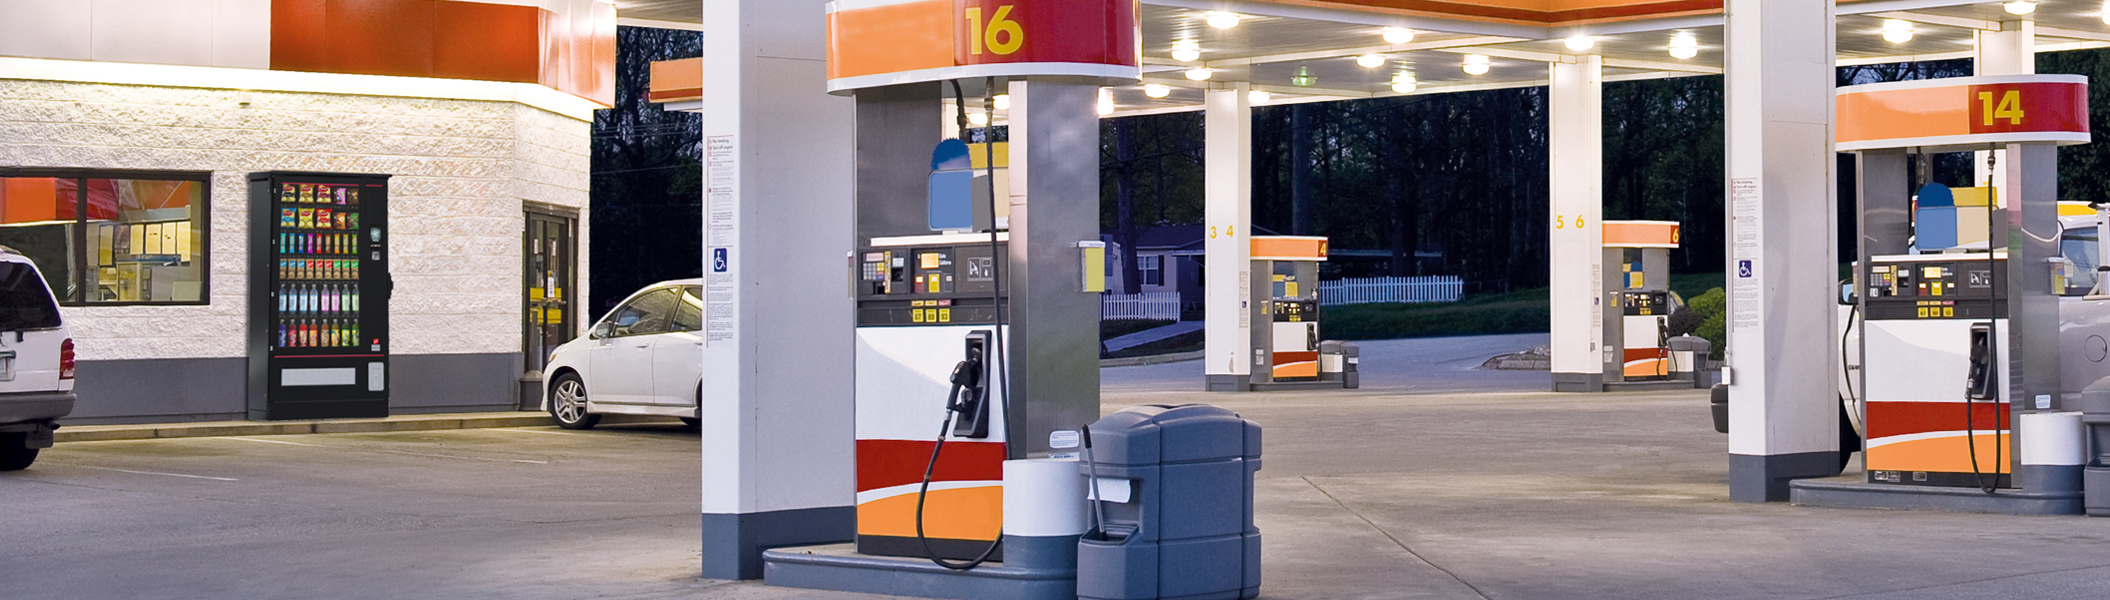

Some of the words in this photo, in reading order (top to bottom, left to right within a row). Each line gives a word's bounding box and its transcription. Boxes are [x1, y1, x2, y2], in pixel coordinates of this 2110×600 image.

[964, 5, 1023, 56] 16
[1978, 91, 2025, 126] 14
[1556, 215, 1564, 229] 5
[1576, 215, 1584, 229] 6
[1210, 226, 1217, 239] 3
[1226, 225, 1233, 238] 4
[1672, 229, 1679, 243] 6
[1320, 243, 1327, 255] 4
